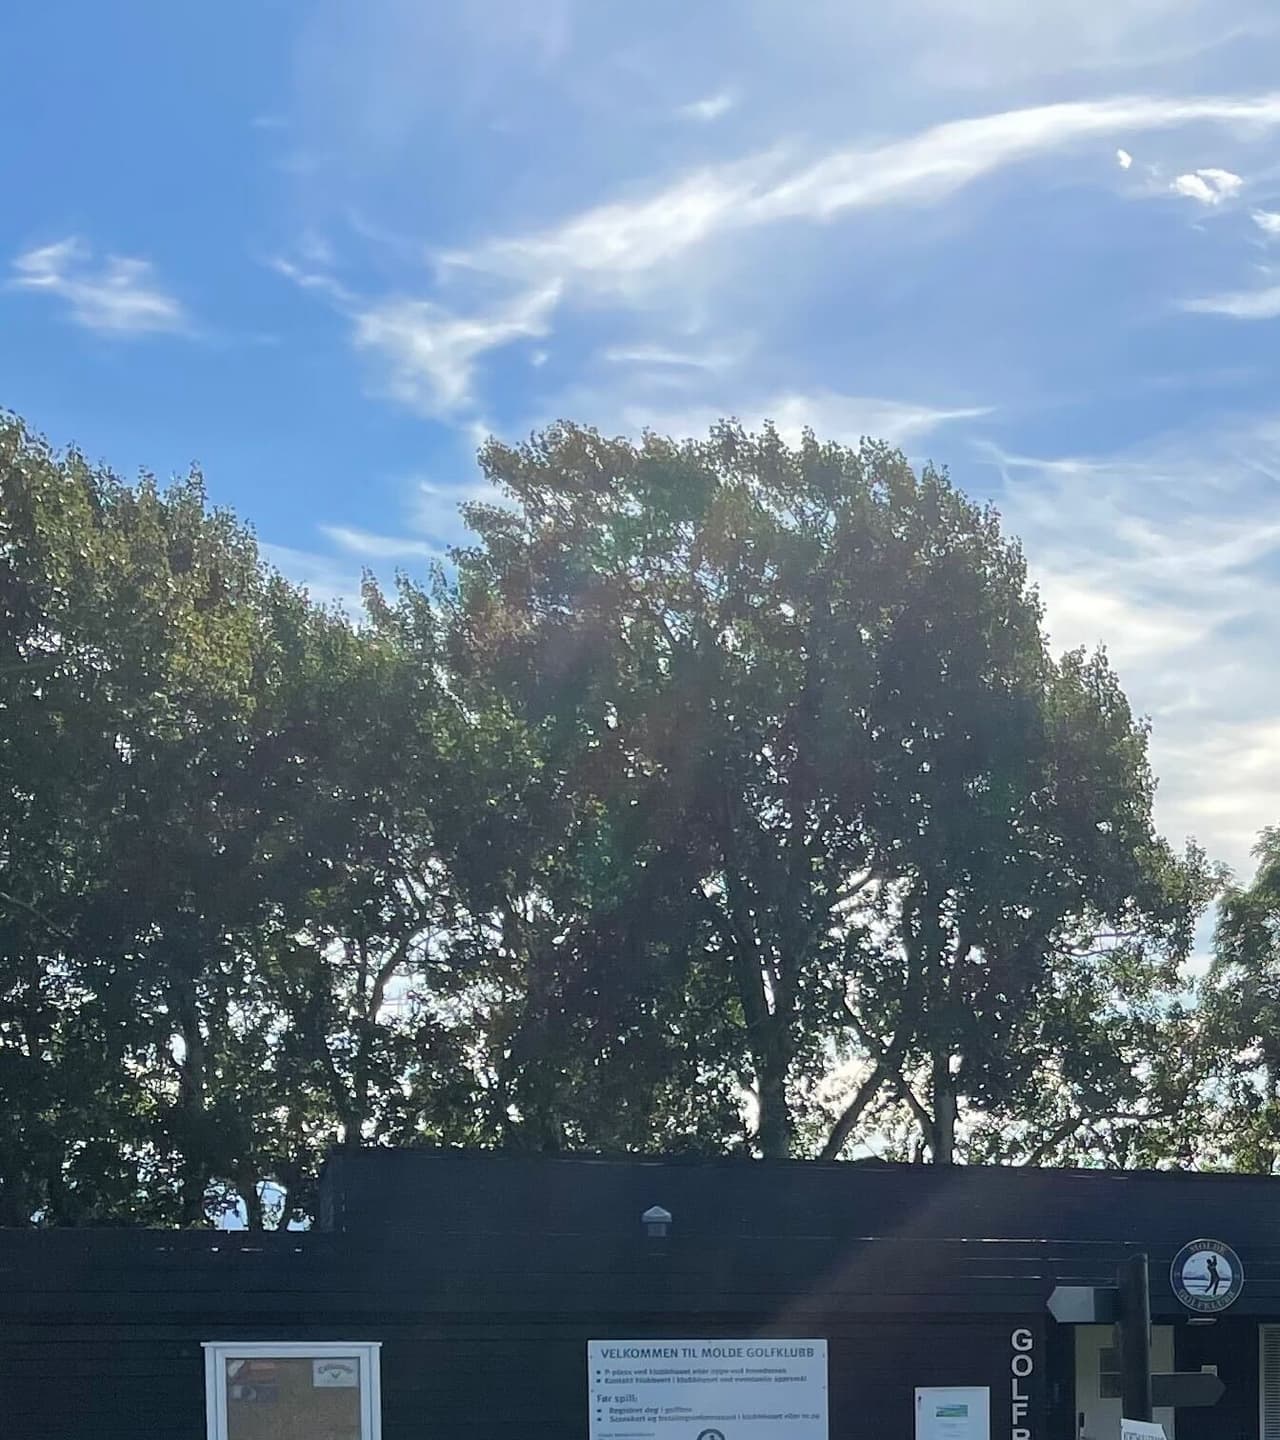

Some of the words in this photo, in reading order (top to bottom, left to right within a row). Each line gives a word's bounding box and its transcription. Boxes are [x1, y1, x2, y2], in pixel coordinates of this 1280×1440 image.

[600, 1347, 679, 1359] VELKOMMEN
[681, 1347, 698, 1359] TIL
[701, 1347, 744, 1359] MOLDE
[746, 1347, 815, 1359] GOLFKLUBB
